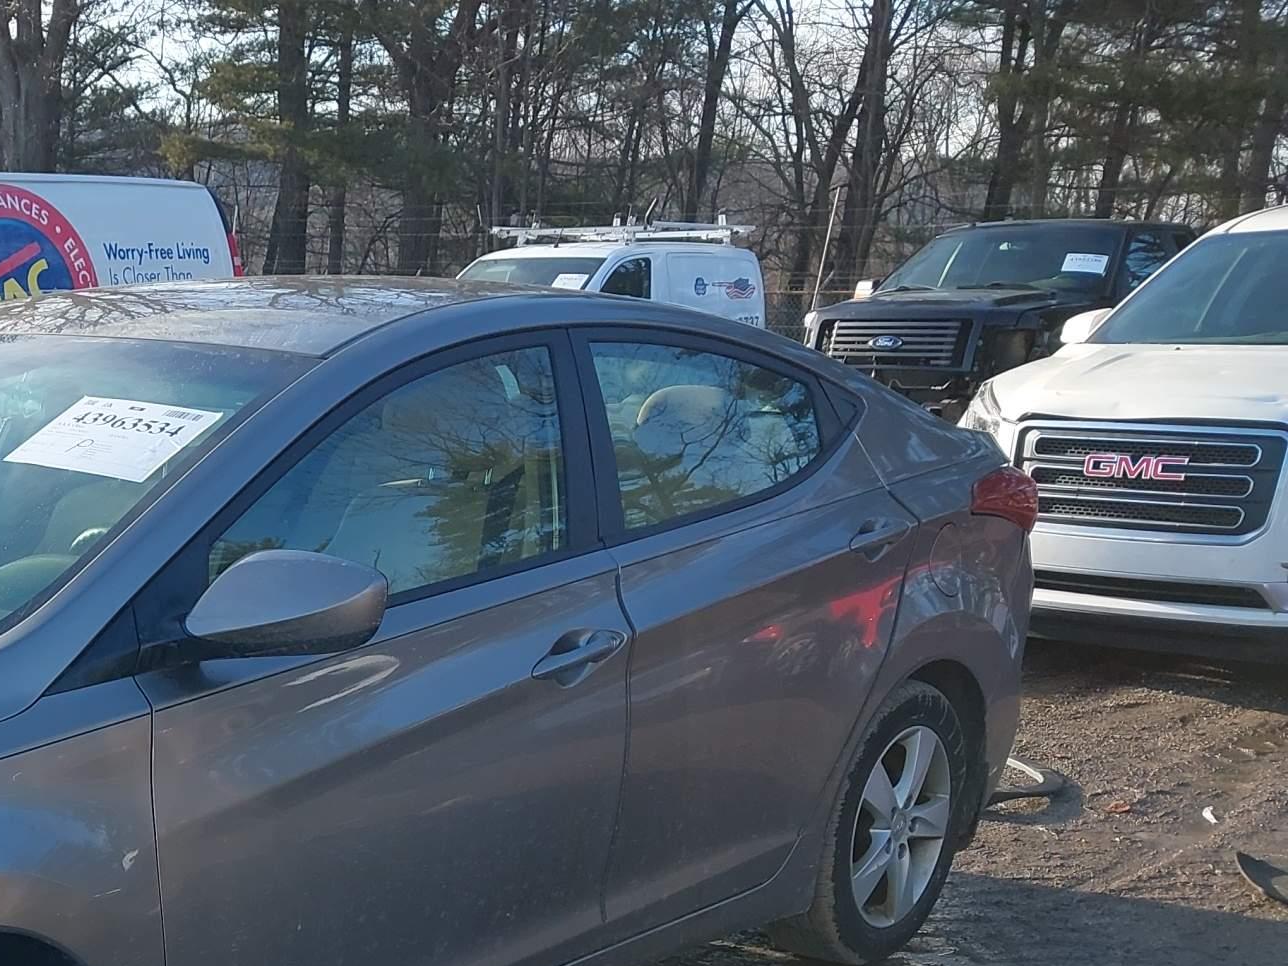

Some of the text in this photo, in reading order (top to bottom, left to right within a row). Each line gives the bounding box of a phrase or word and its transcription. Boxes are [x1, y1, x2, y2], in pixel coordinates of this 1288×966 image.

[103, 241, 210, 265] Worry-Free Living
[109, 267, 119, 286] Is
[72, 410, 186, 438] 43963534
[1083, 453, 1190, 481] GMC
